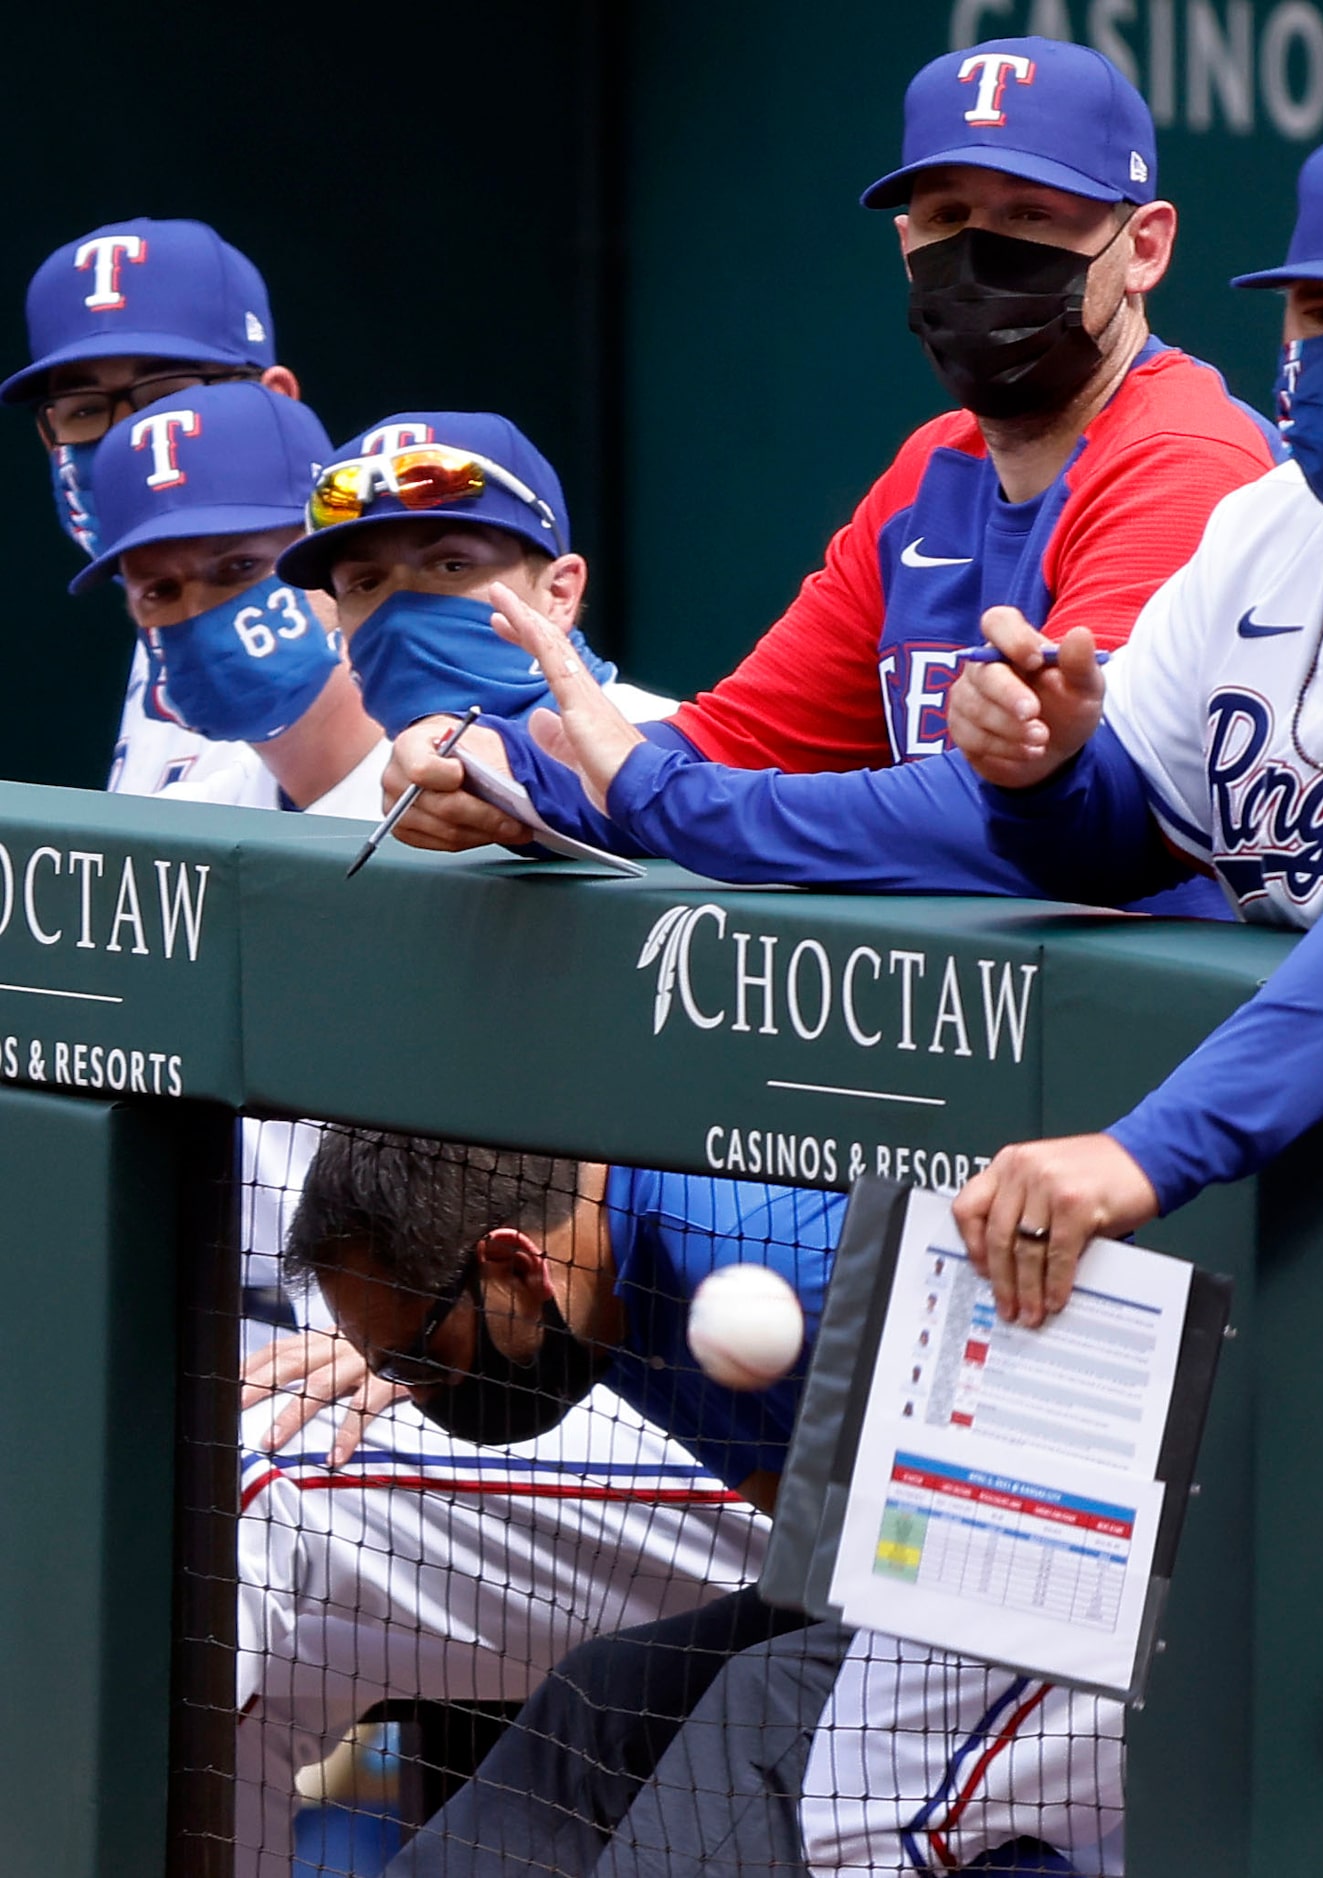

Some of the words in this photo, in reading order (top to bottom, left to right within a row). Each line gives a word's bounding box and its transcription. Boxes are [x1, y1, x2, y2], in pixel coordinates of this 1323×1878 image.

[957, 53, 1036, 127] T
[75, 235, 146, 312] T
[131, 409, 200, 491] T
[232, 586, 308, 660] 63
[677, 903, 1039, 1064] CHOCTAW
[28, 1039, 47, 1082] &
[55, 1041, 183, 1098] RESORTS
[706, 1125, 838, 1182] CASINOS
[876, 1144, 994, 1190] RESOR
